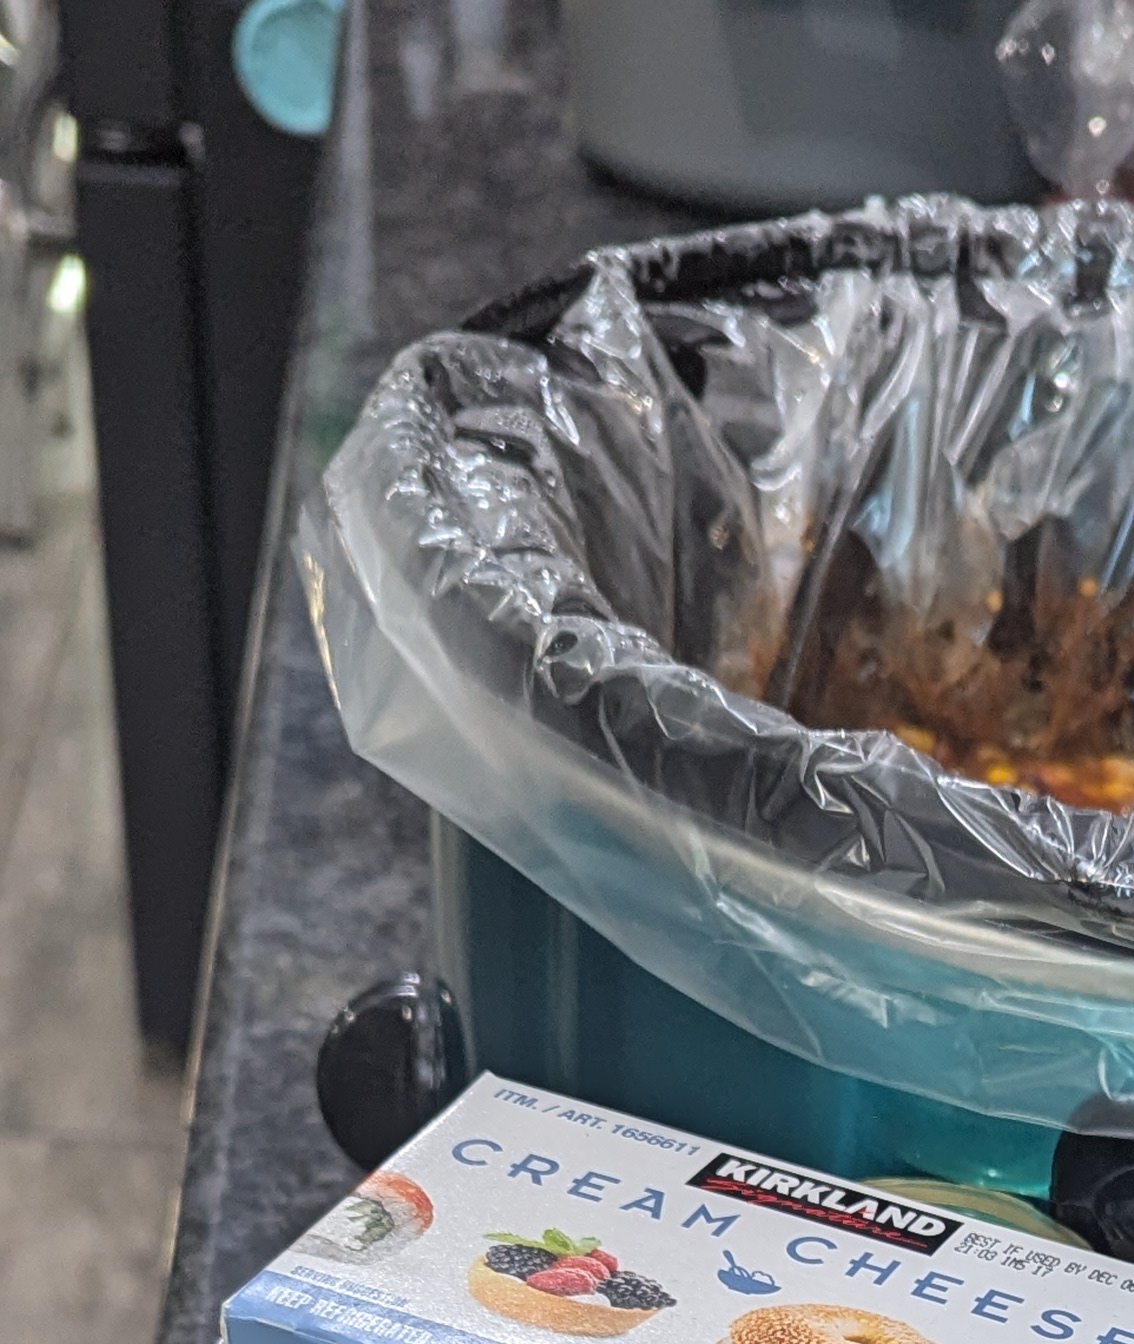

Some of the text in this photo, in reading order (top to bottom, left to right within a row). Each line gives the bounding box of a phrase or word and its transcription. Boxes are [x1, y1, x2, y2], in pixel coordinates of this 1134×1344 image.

[494, 1089, 537, 1110] ITM.
[557, 1109, 607, 1130] ART.
[611, 1124, 701, 1156] 1656611
[452, 1139, 741, 1237] CREAM
[716, 1158, 946, 1238] KIRKLAND
[964, 1233, 1001, 1250] BEST
[1002, 1244, 1023, 1255] IF
[1025, 1251, 1061, 1268] USED
[1064, 1262, 1087, 1276] BY
[1088, 1269, 1118, 1285] DEC
[266, 1286, 313, 1309] KEEP
